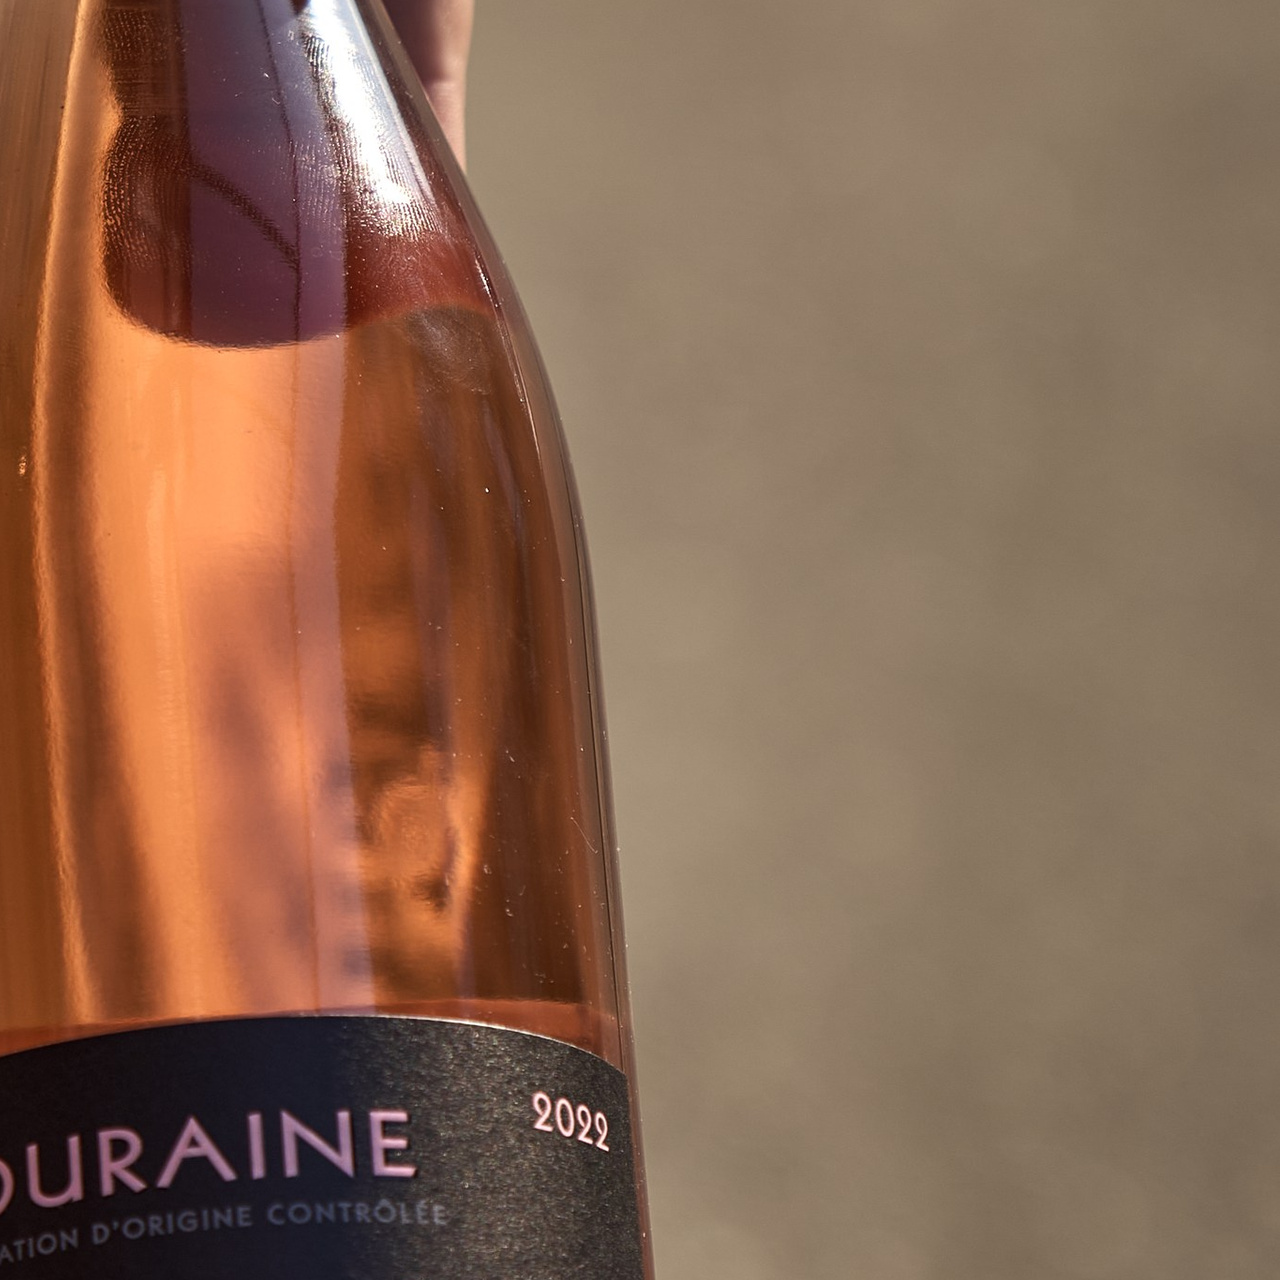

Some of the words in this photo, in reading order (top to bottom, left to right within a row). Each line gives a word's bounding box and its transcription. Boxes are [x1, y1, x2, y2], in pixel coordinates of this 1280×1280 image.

[532, 1091, 610, 1152] 2022
[91, 1205, 252, 1246] D'ORIGINE
[267, 1198, 448, 1226] CONTRÔLÉE
